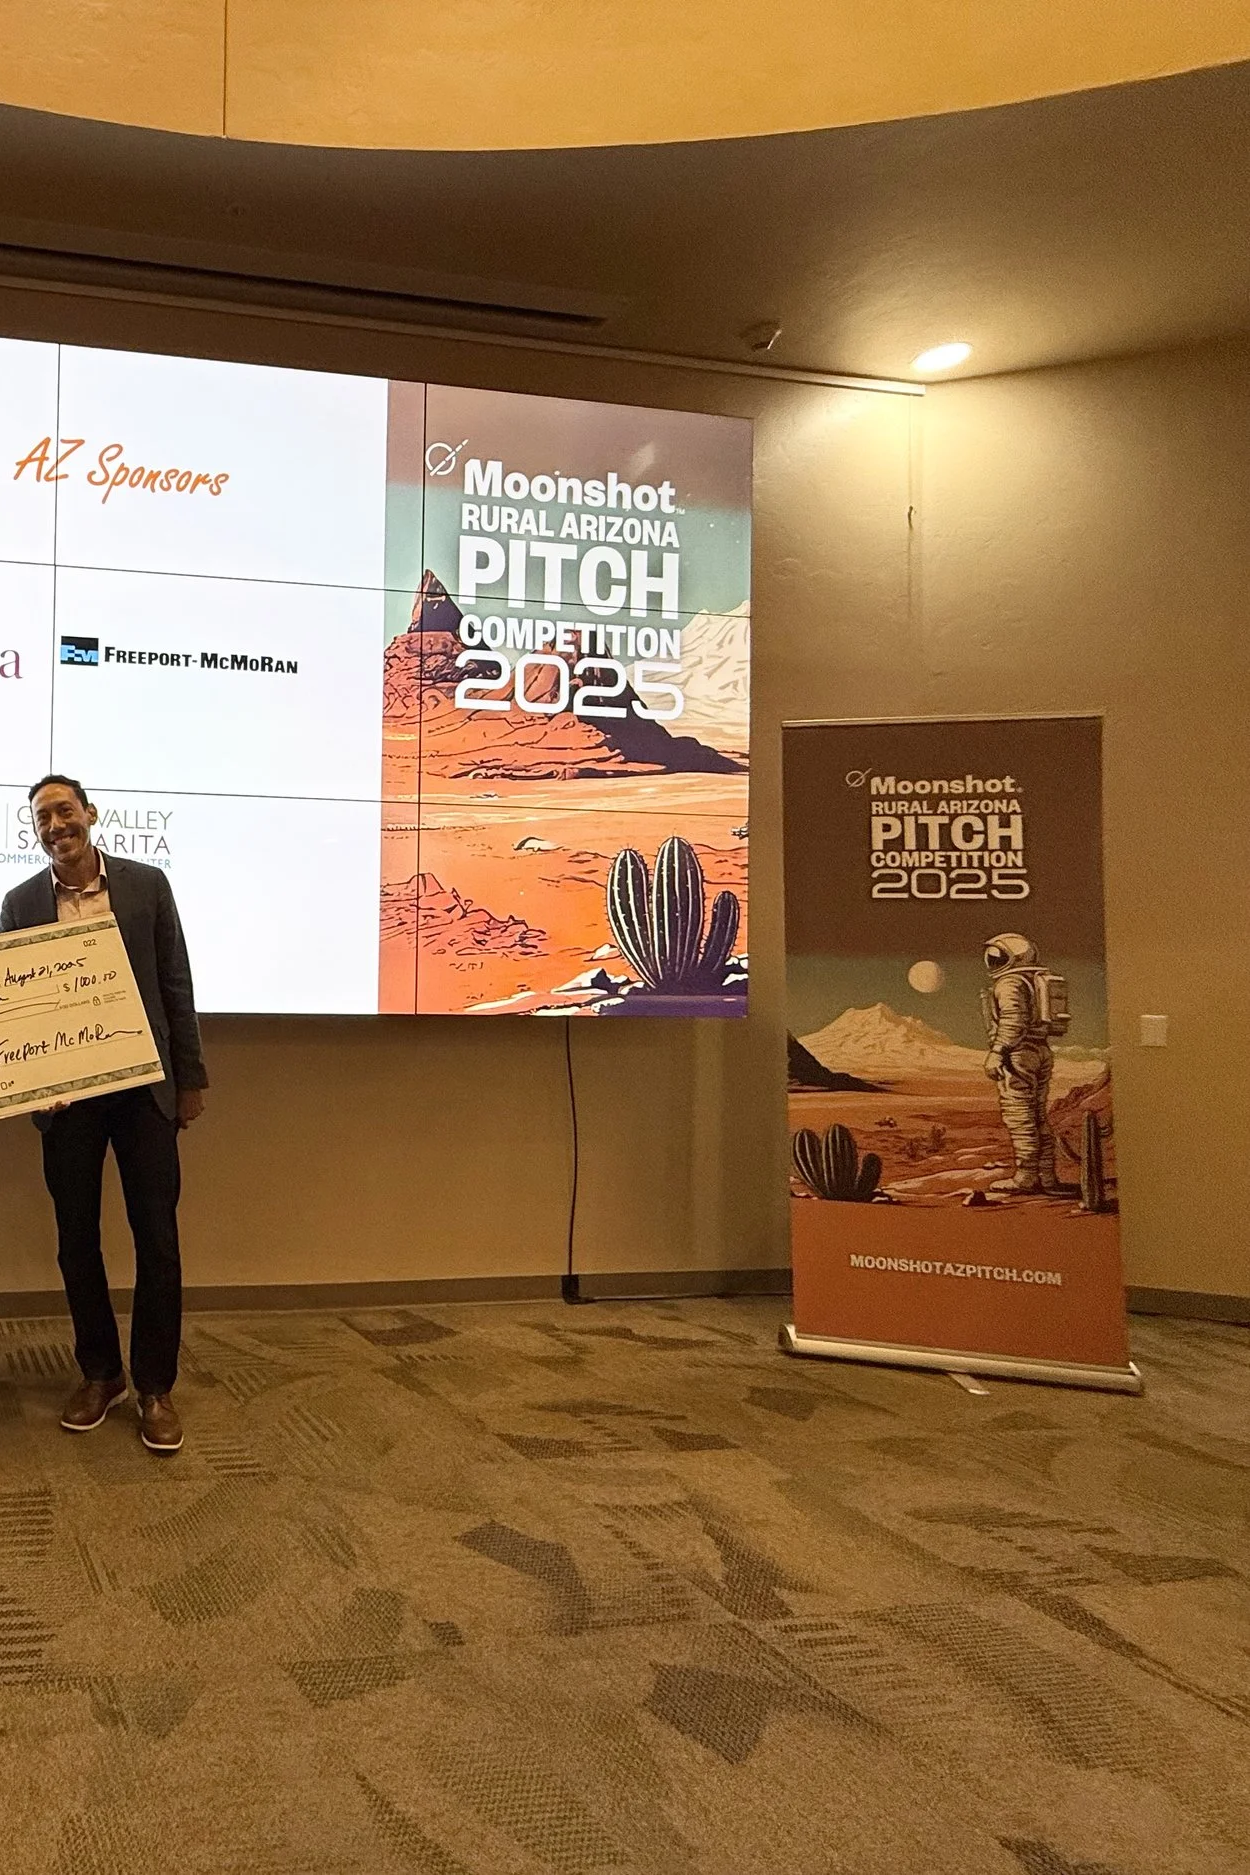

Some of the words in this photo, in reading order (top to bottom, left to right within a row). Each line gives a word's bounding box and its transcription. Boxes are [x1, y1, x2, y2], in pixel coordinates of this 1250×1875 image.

[13, 436, 85, 483] AZ
[86, 443, 231, 504] Sponsors
[464, 458, 676, 514] Moonshot
[461, 503, 554, 537] RURAL
[560, 512, 680, 548] ARIZONA
[458, 535, 679, 620] PITCH
[459, 614, 681, 659] COMPETITION
[454, 649, 684, 721] 2025
[870, 775, 1016, 796] Moonshot
[97, 809, 173, 830] VALLEY
[871, 800, 933, 815] RURAL
[937, 799, 1021, 815] ARIZONA
[18, 830, 170, 854] SARITA
[871, 815, 1024, 850] PITCH
[870, 851, 1023, 867] COMPETITION
[871, 868, 1030, 899] 2025
[83, 939, 98, 948] 022
[850, 1254, 1062, 1286] MOONSHOTAZPITCH.COM
